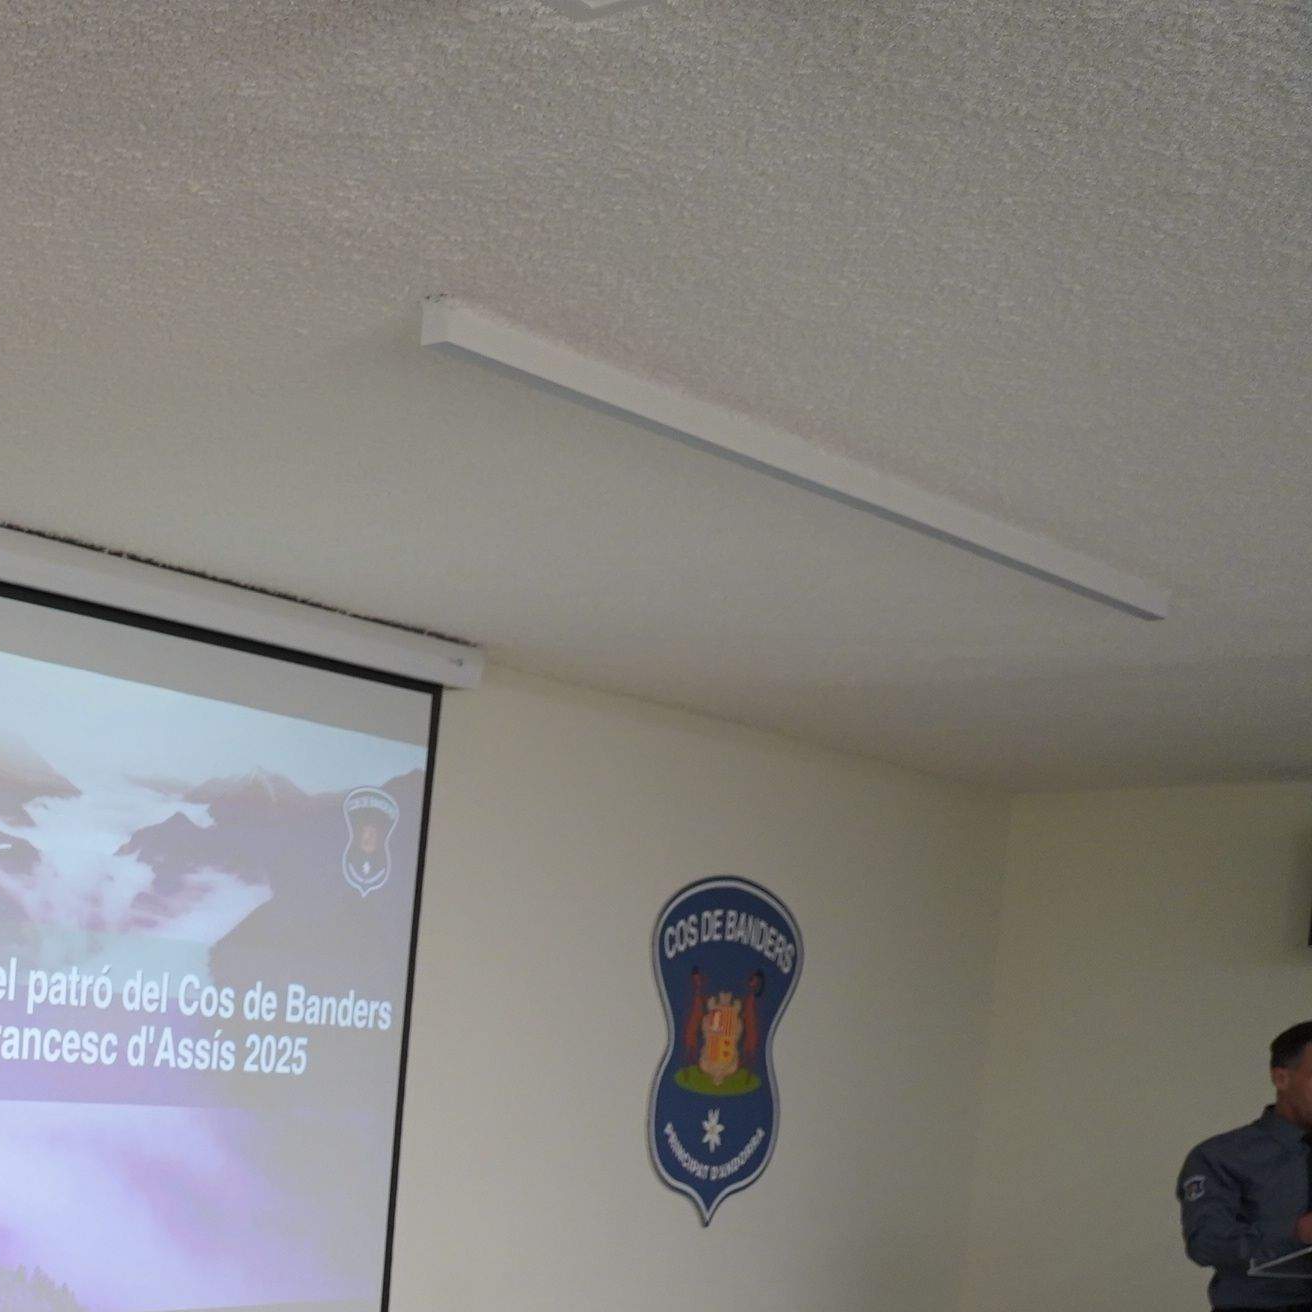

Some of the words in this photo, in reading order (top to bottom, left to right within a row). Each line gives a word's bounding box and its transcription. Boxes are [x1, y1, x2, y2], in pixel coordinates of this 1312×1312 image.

[664, 914, 698, 959] COS
[701, 909, 724, 942] DE
[725, 909, 795, 974] BANDERS
[27, 965, 112, 1015] patró
[122, 969, 170, 1013] del
[178, 973, 235, 1020] Cos
[243, 981, 278, 1021] de
[285, 983, 393, 1030] Banders
[126, 1025, 236, 1071] d'Assís
[243, 1034, 308, 1075] 2025
